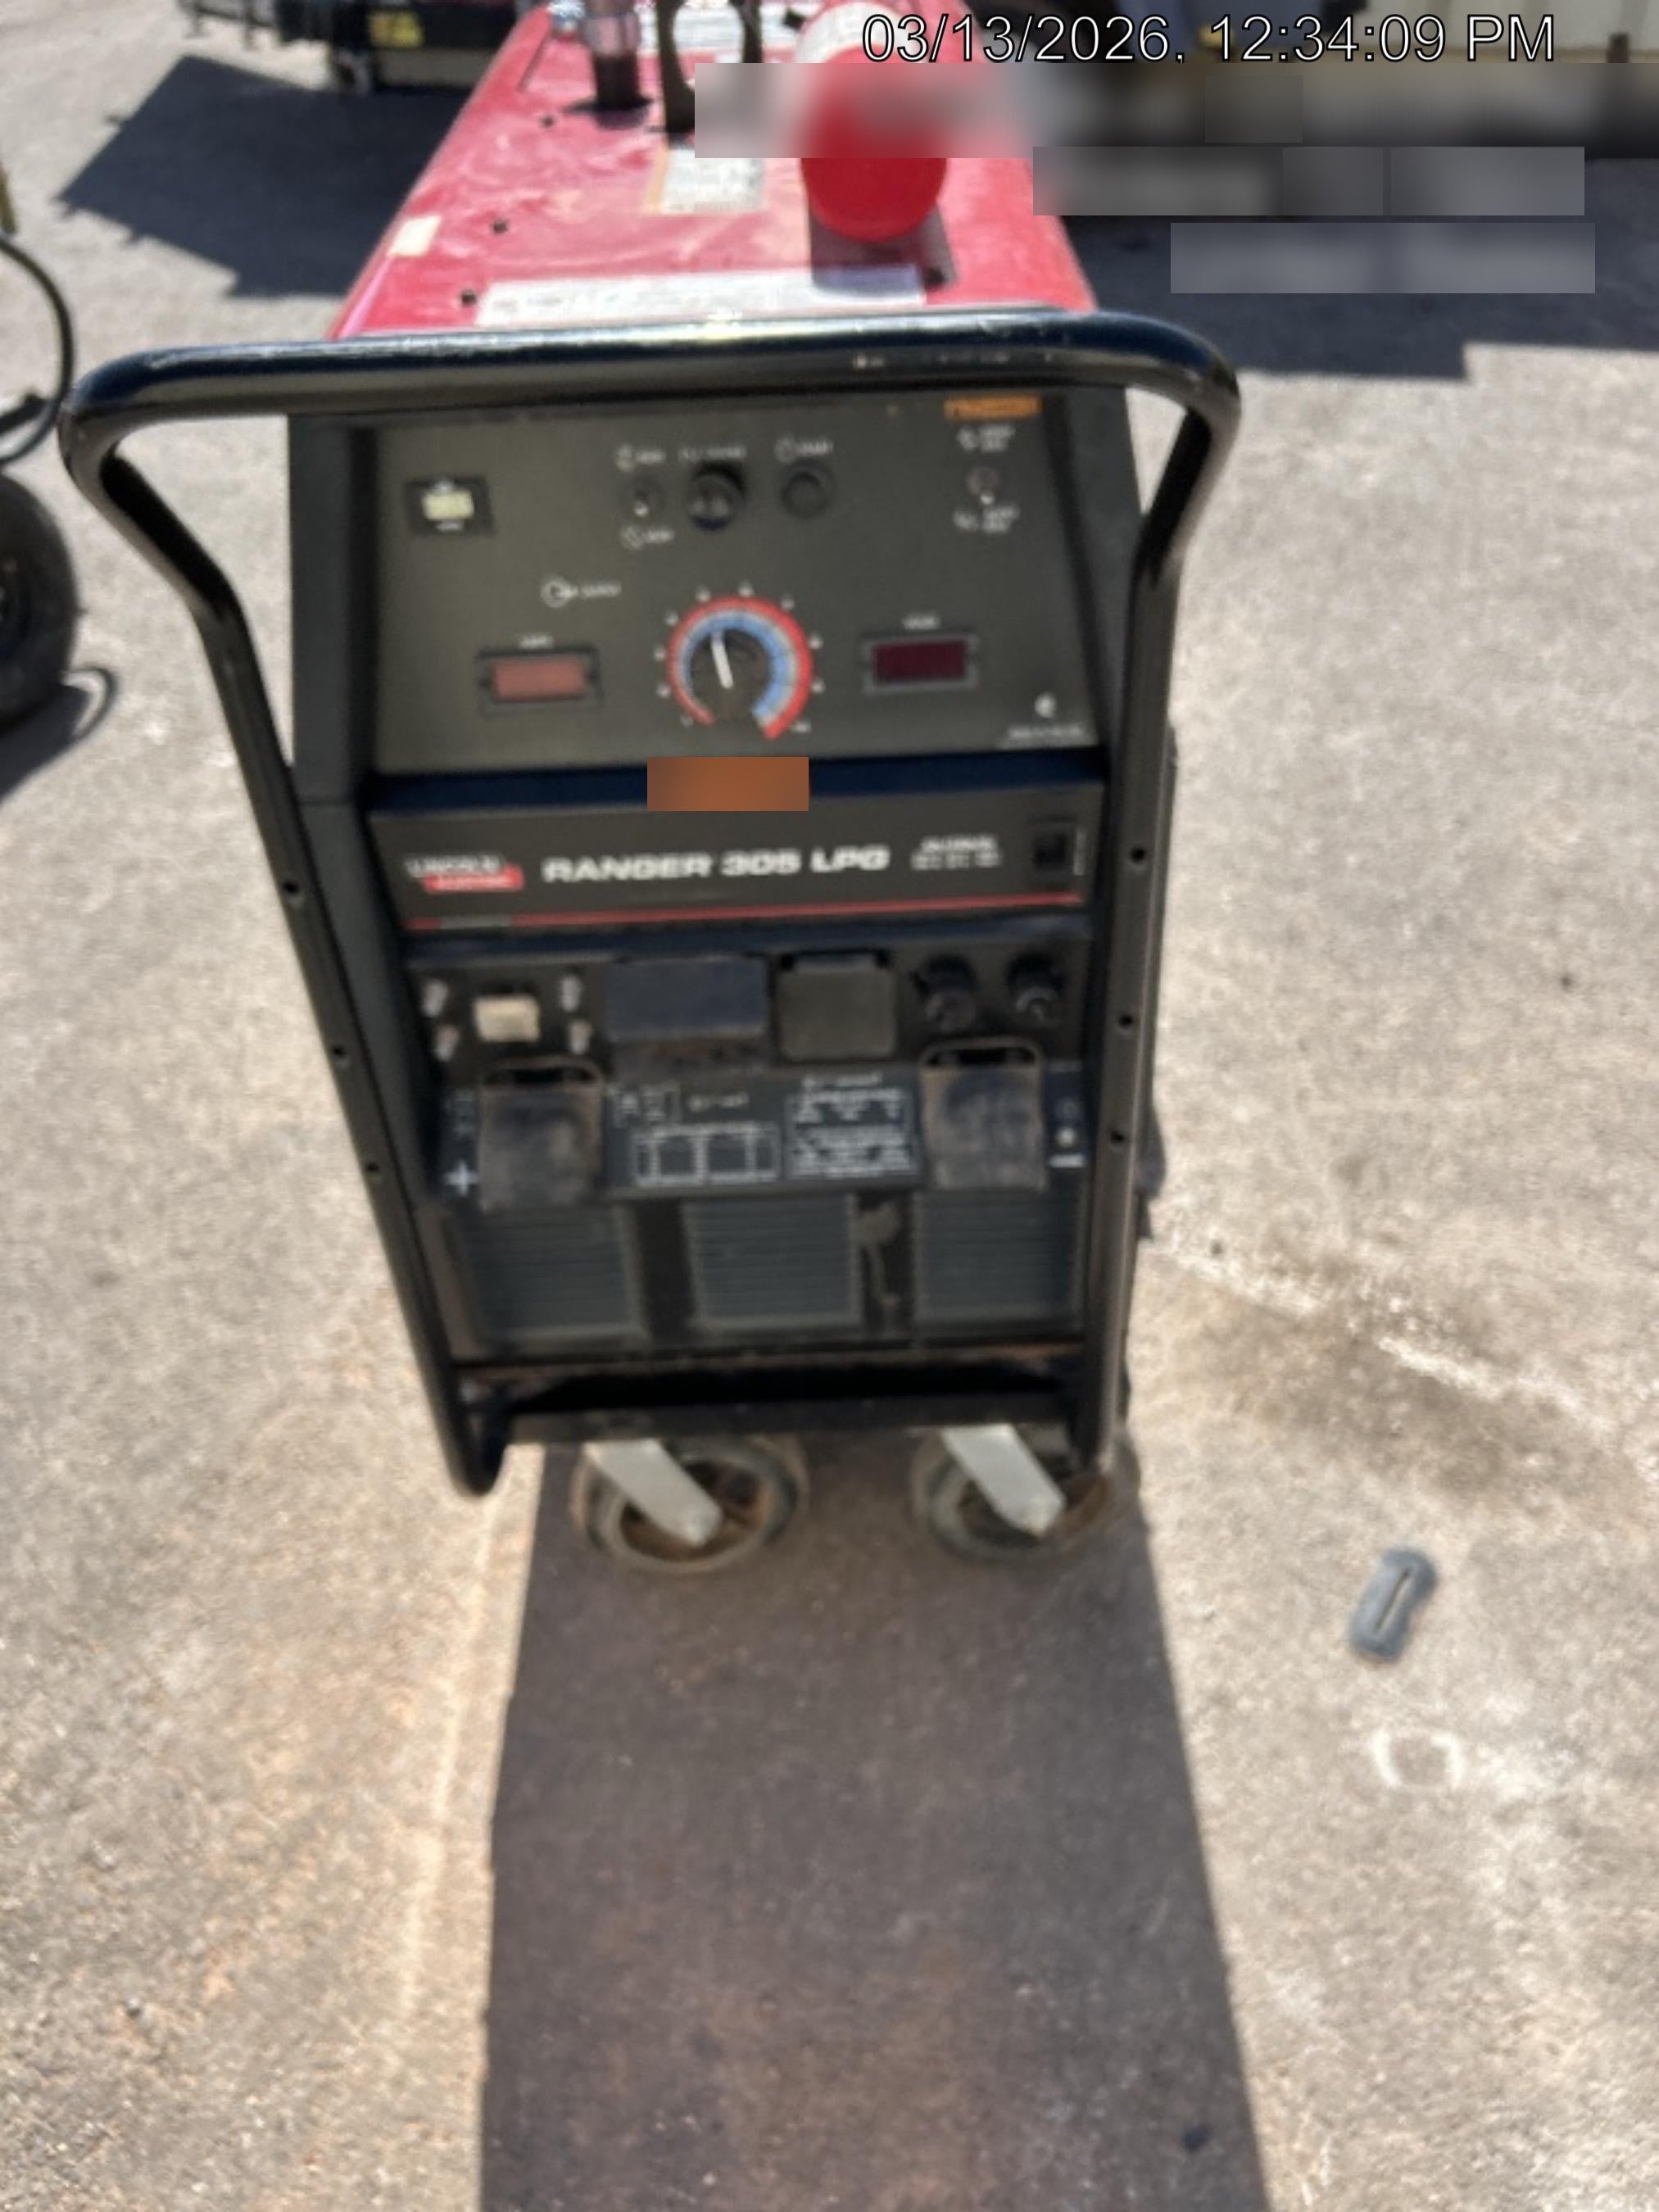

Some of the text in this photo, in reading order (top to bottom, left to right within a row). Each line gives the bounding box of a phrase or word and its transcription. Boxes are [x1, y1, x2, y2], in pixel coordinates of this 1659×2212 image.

[542, 852, 713, 882] RANGER
[722, 848, 801, 876] 305
[810, 844, 891, 873] LPG
